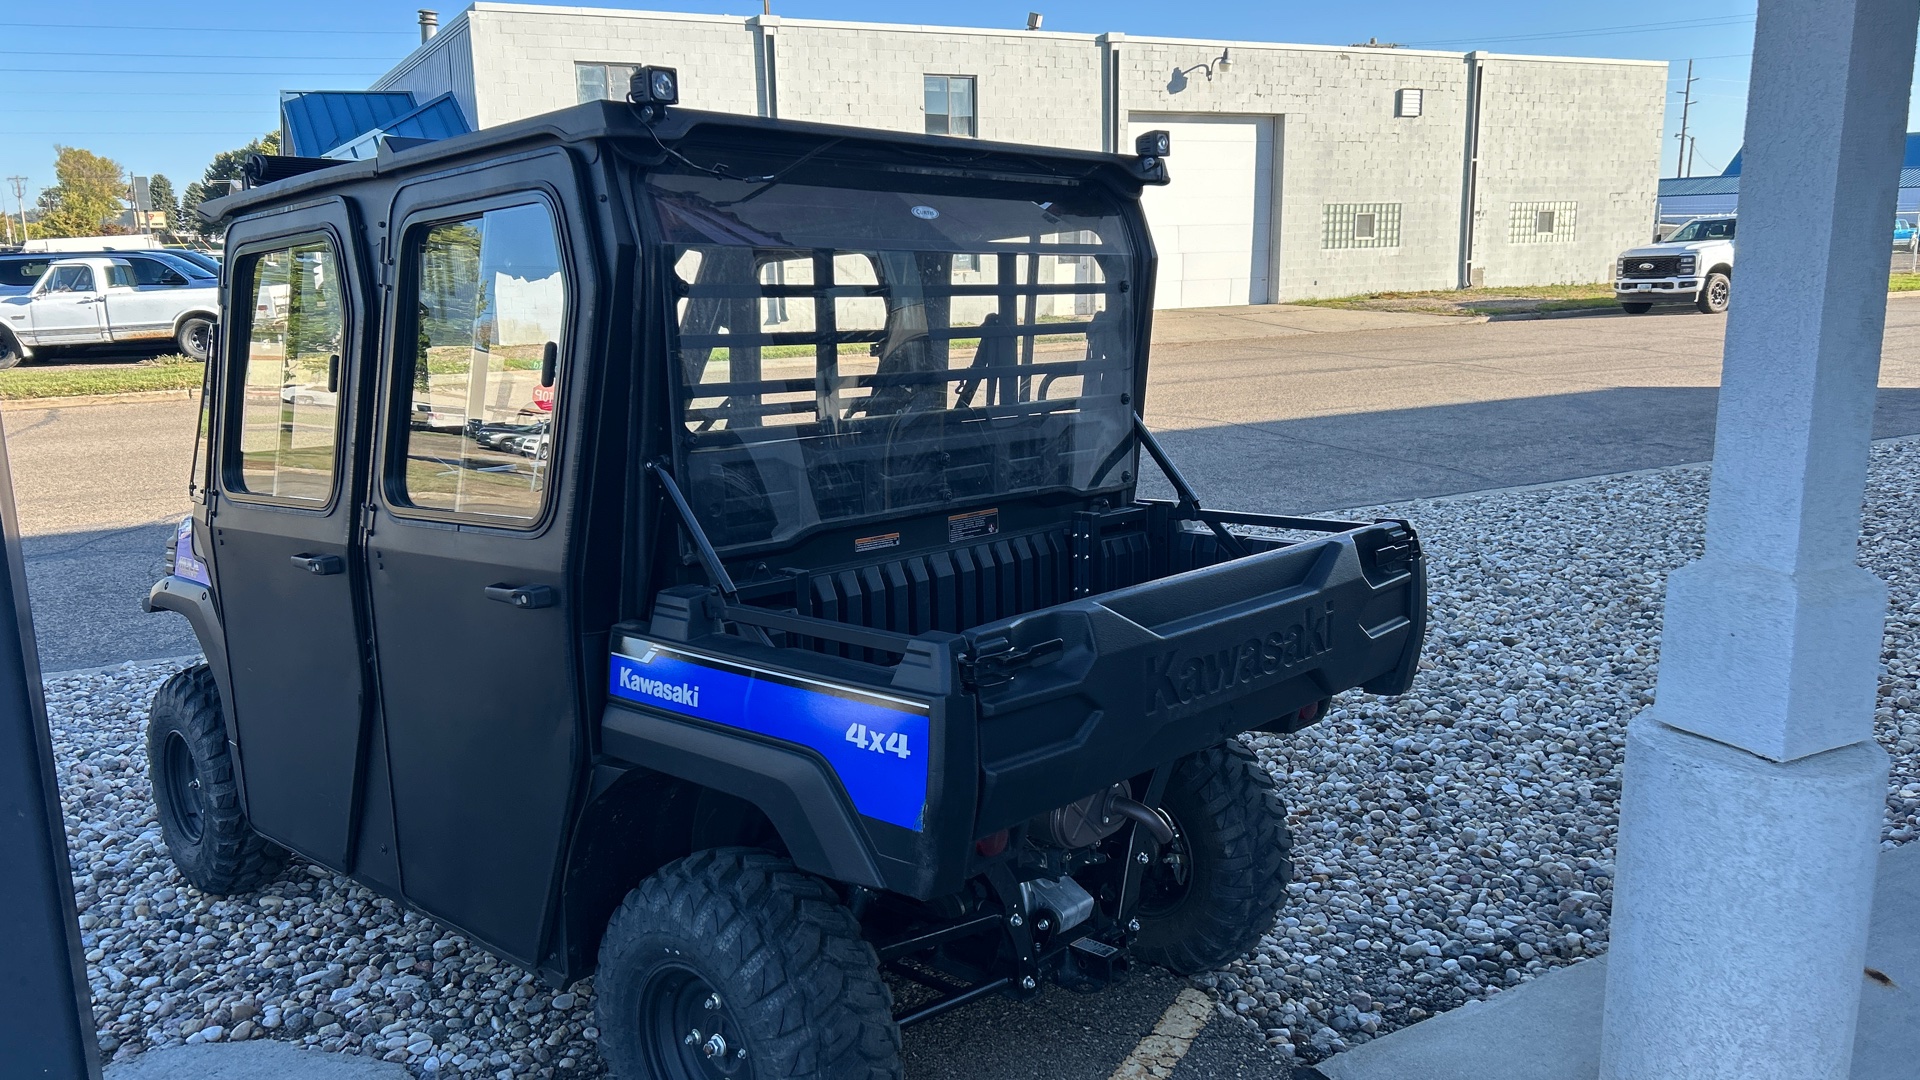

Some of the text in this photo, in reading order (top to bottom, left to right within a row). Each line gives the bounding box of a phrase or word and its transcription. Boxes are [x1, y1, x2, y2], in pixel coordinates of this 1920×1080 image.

[1144, 600, 1334, 717] Kawasaki
[619, 666, 699, 708] Kawasaki
[845, 722, 911, 760] 4x4
